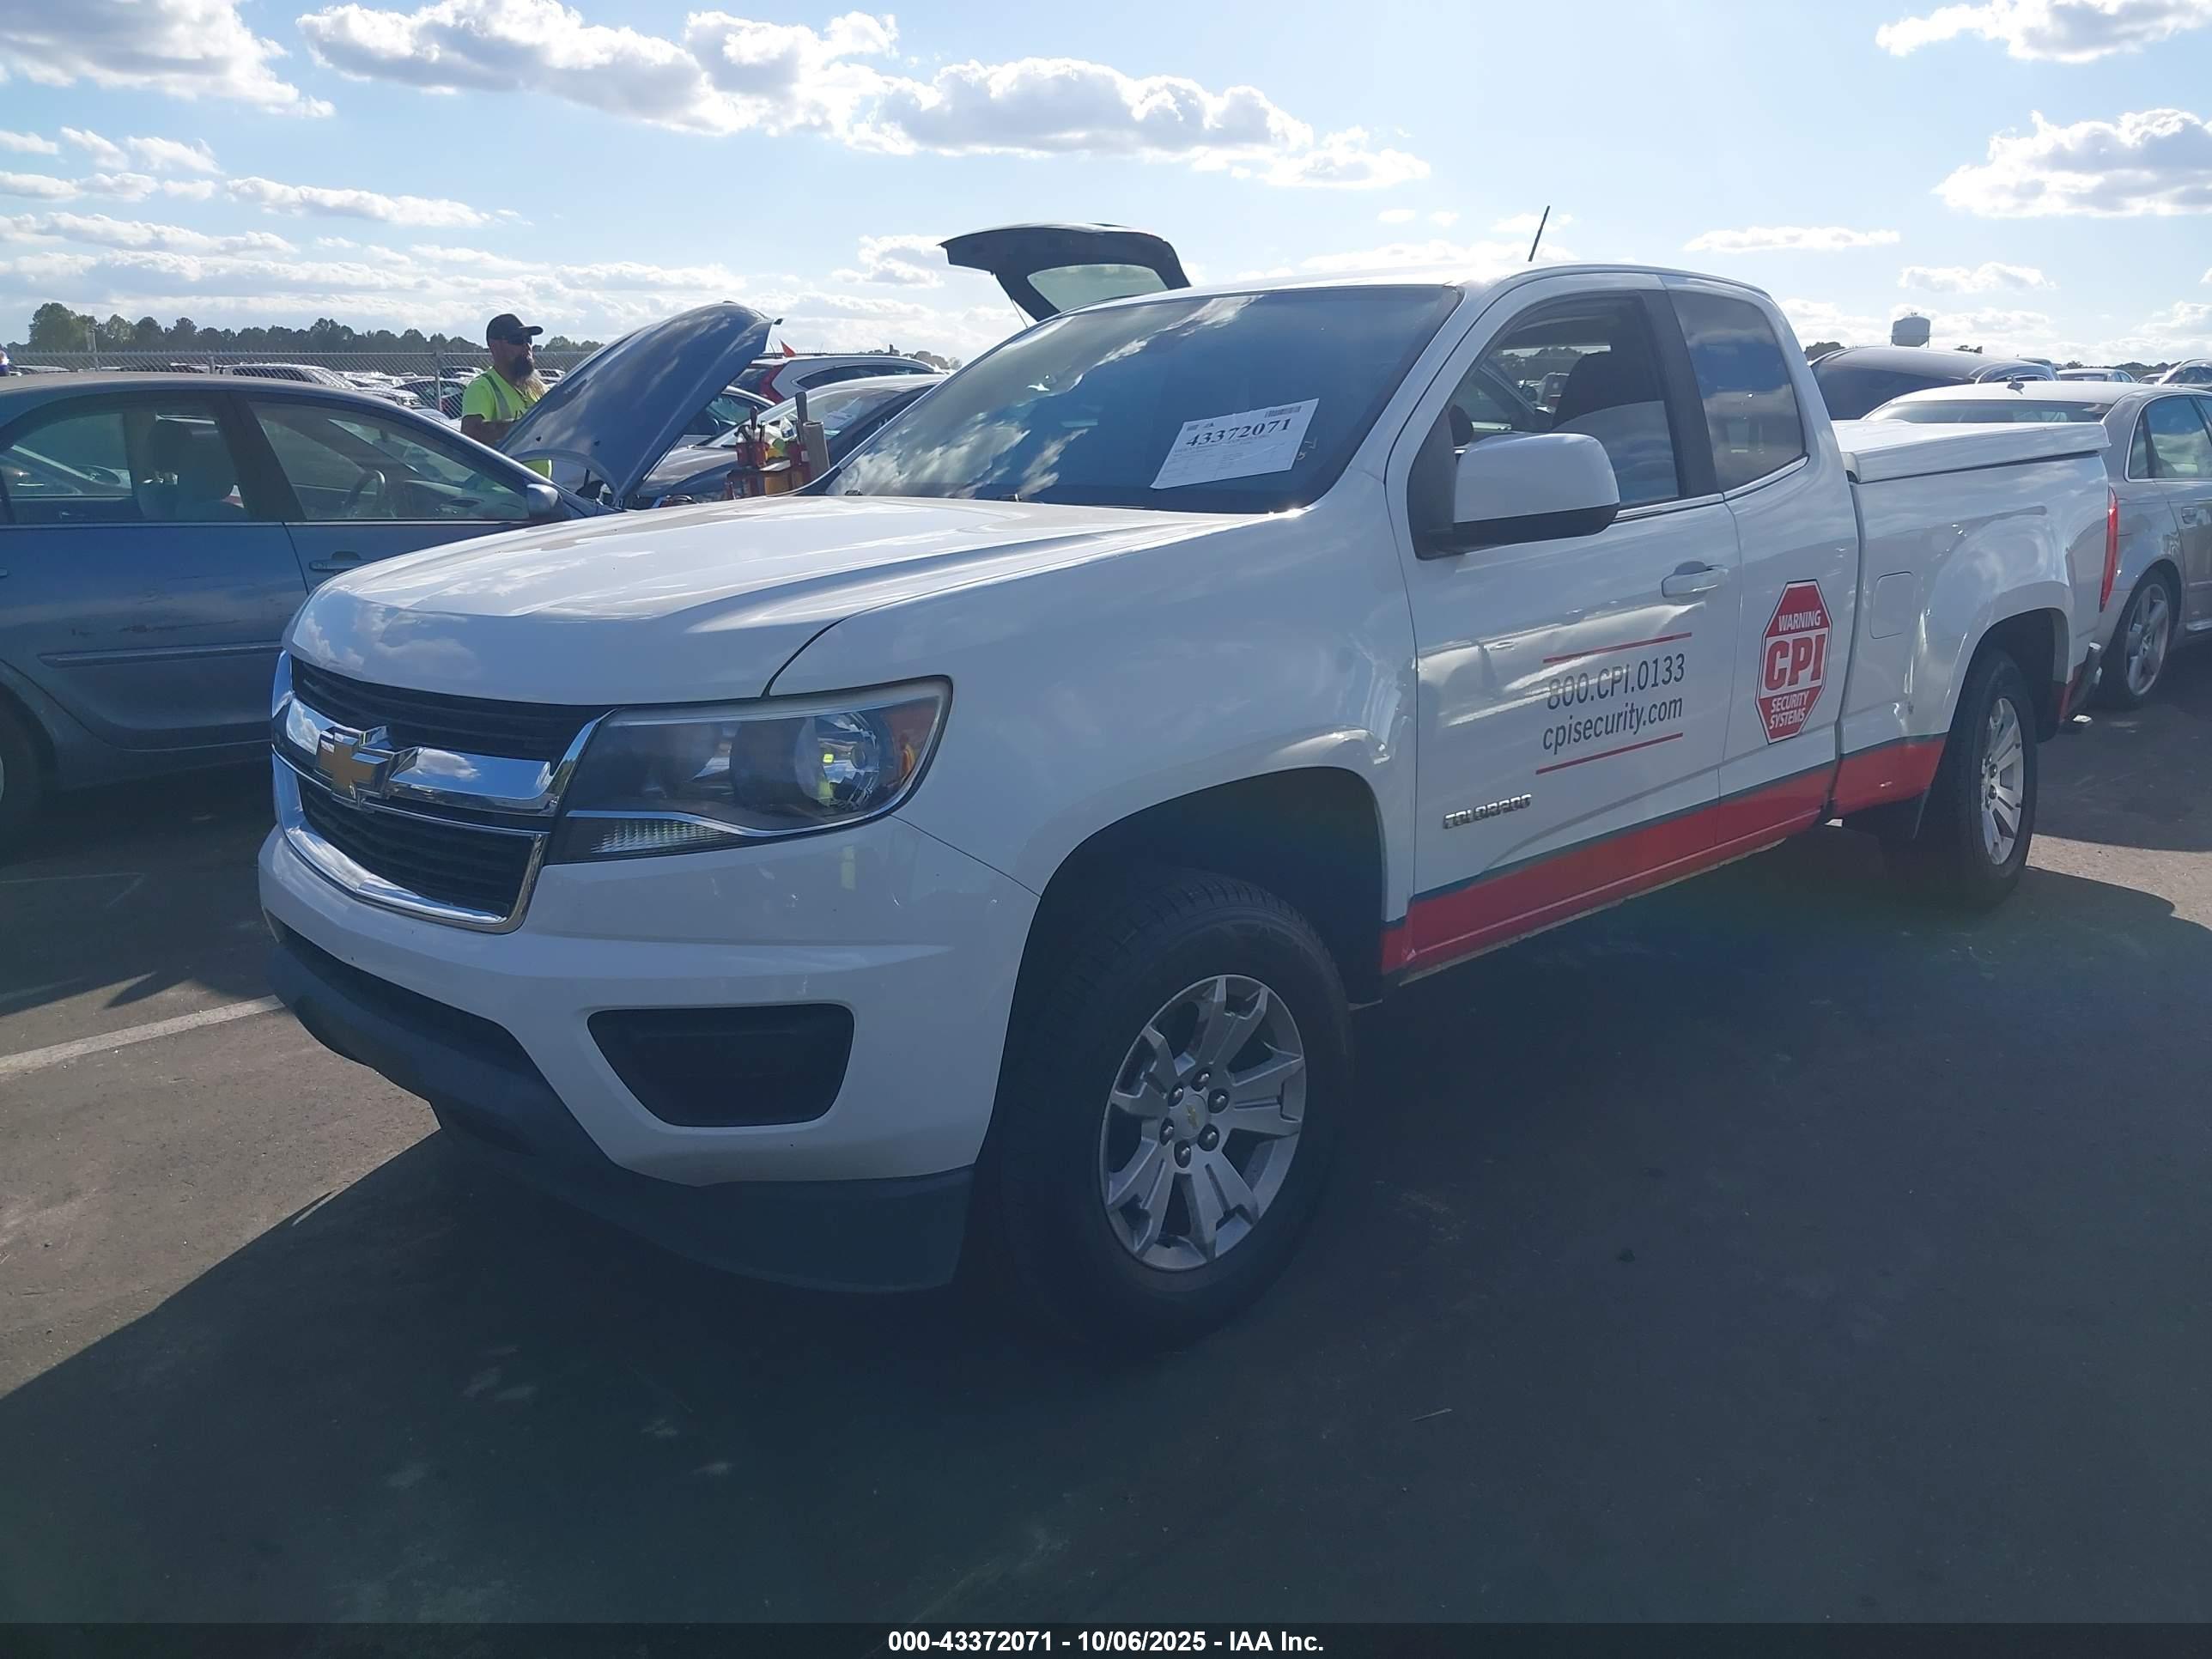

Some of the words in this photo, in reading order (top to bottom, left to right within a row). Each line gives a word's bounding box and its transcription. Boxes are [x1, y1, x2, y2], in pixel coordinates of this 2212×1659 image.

[1186, 418, 1291, 447] 43372071
[1778, 610, 1821, 632] WARNING
[1765, 634, 1826, 691] CPI
[1547, 653, 1686, 710] 800.CPI.0133
[1771, 690, 1810, 714] SECURITY
[1542, 696, 1683, 755] cpisecurity.com
[1769, 707, 1806, 730] SYSTEMS
